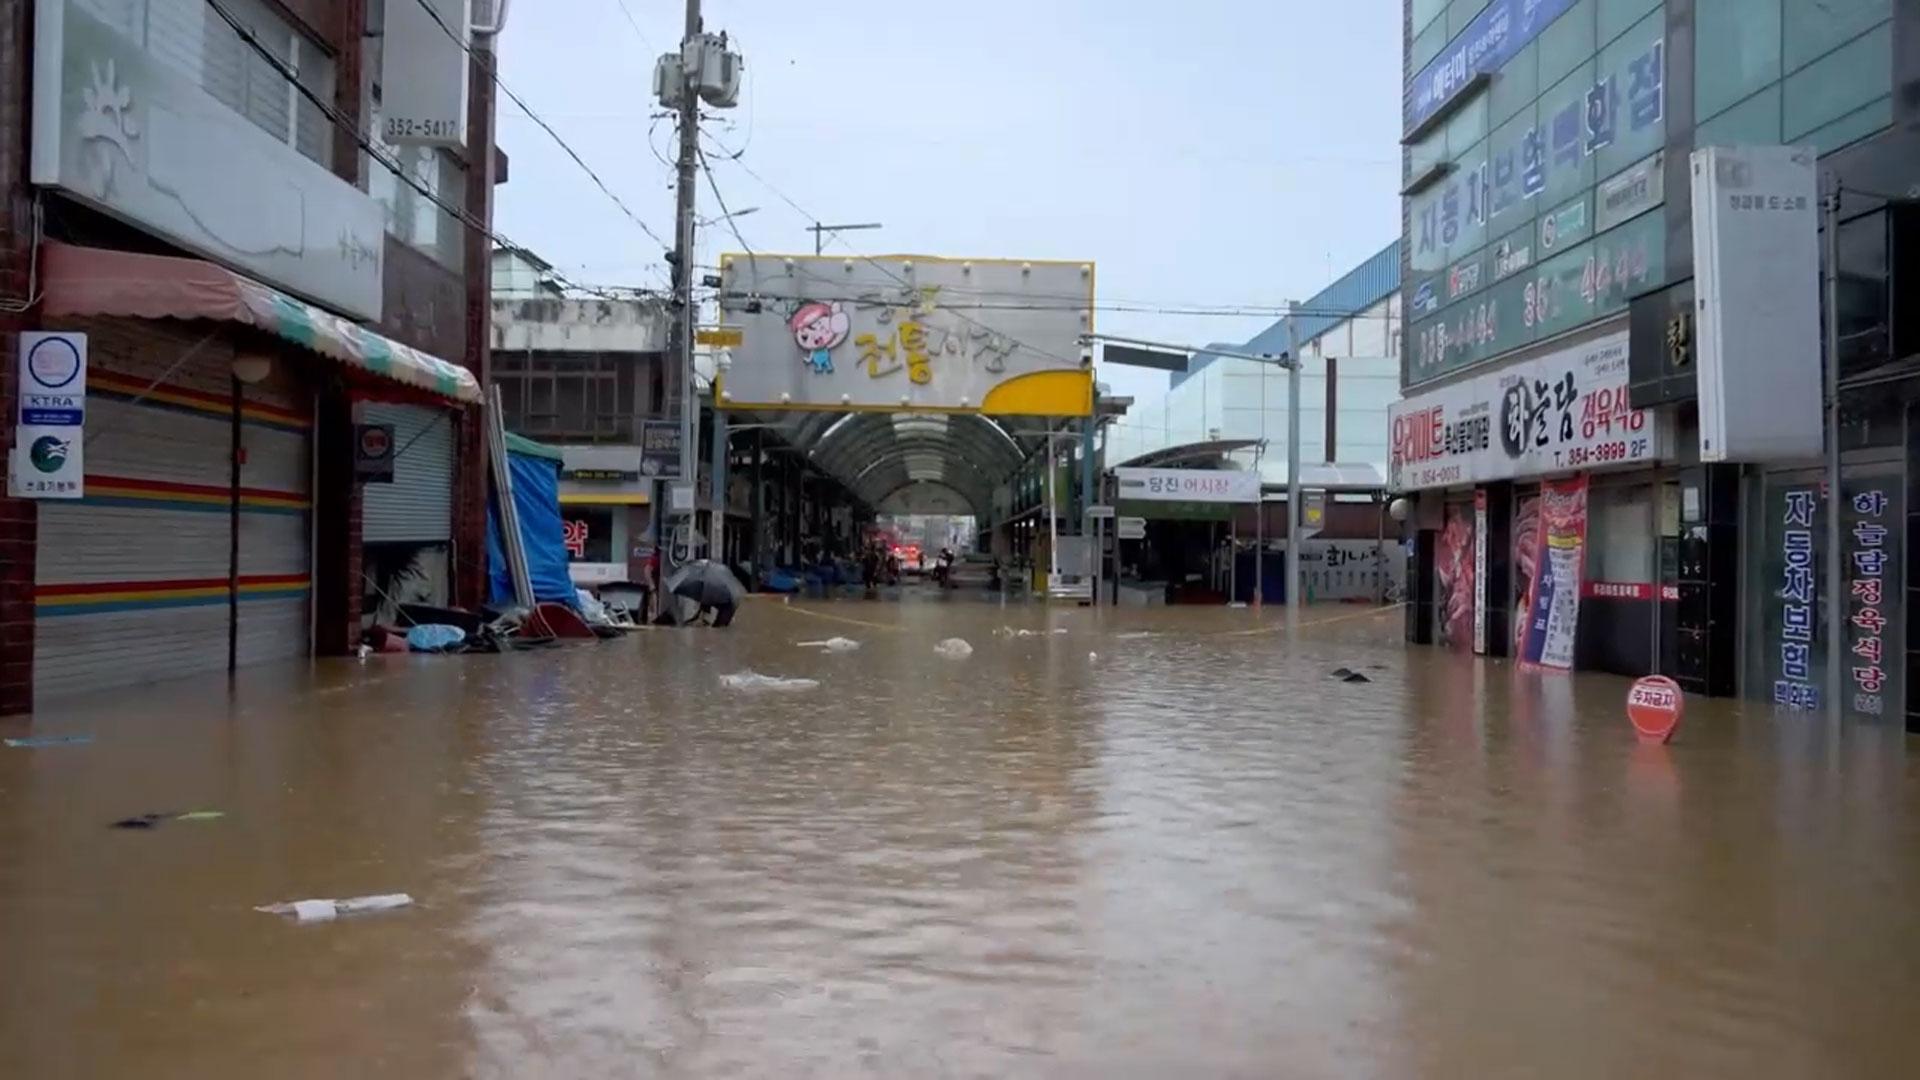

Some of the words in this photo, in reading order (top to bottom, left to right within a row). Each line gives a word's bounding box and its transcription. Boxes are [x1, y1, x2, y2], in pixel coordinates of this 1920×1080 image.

[387, 118, 456, 137] 352-5417
[1568, 441, 1626, 466] 354-3999
[1631, 439, 1647, 457] 2F
[1150, 477, 1179, 493] 당진
[1184, 478, 1229, 493] 어시장
[1783, 491, 1815, 680] 자동차보험
[1852, 491, 1887, 693] 하늘담정육식당
